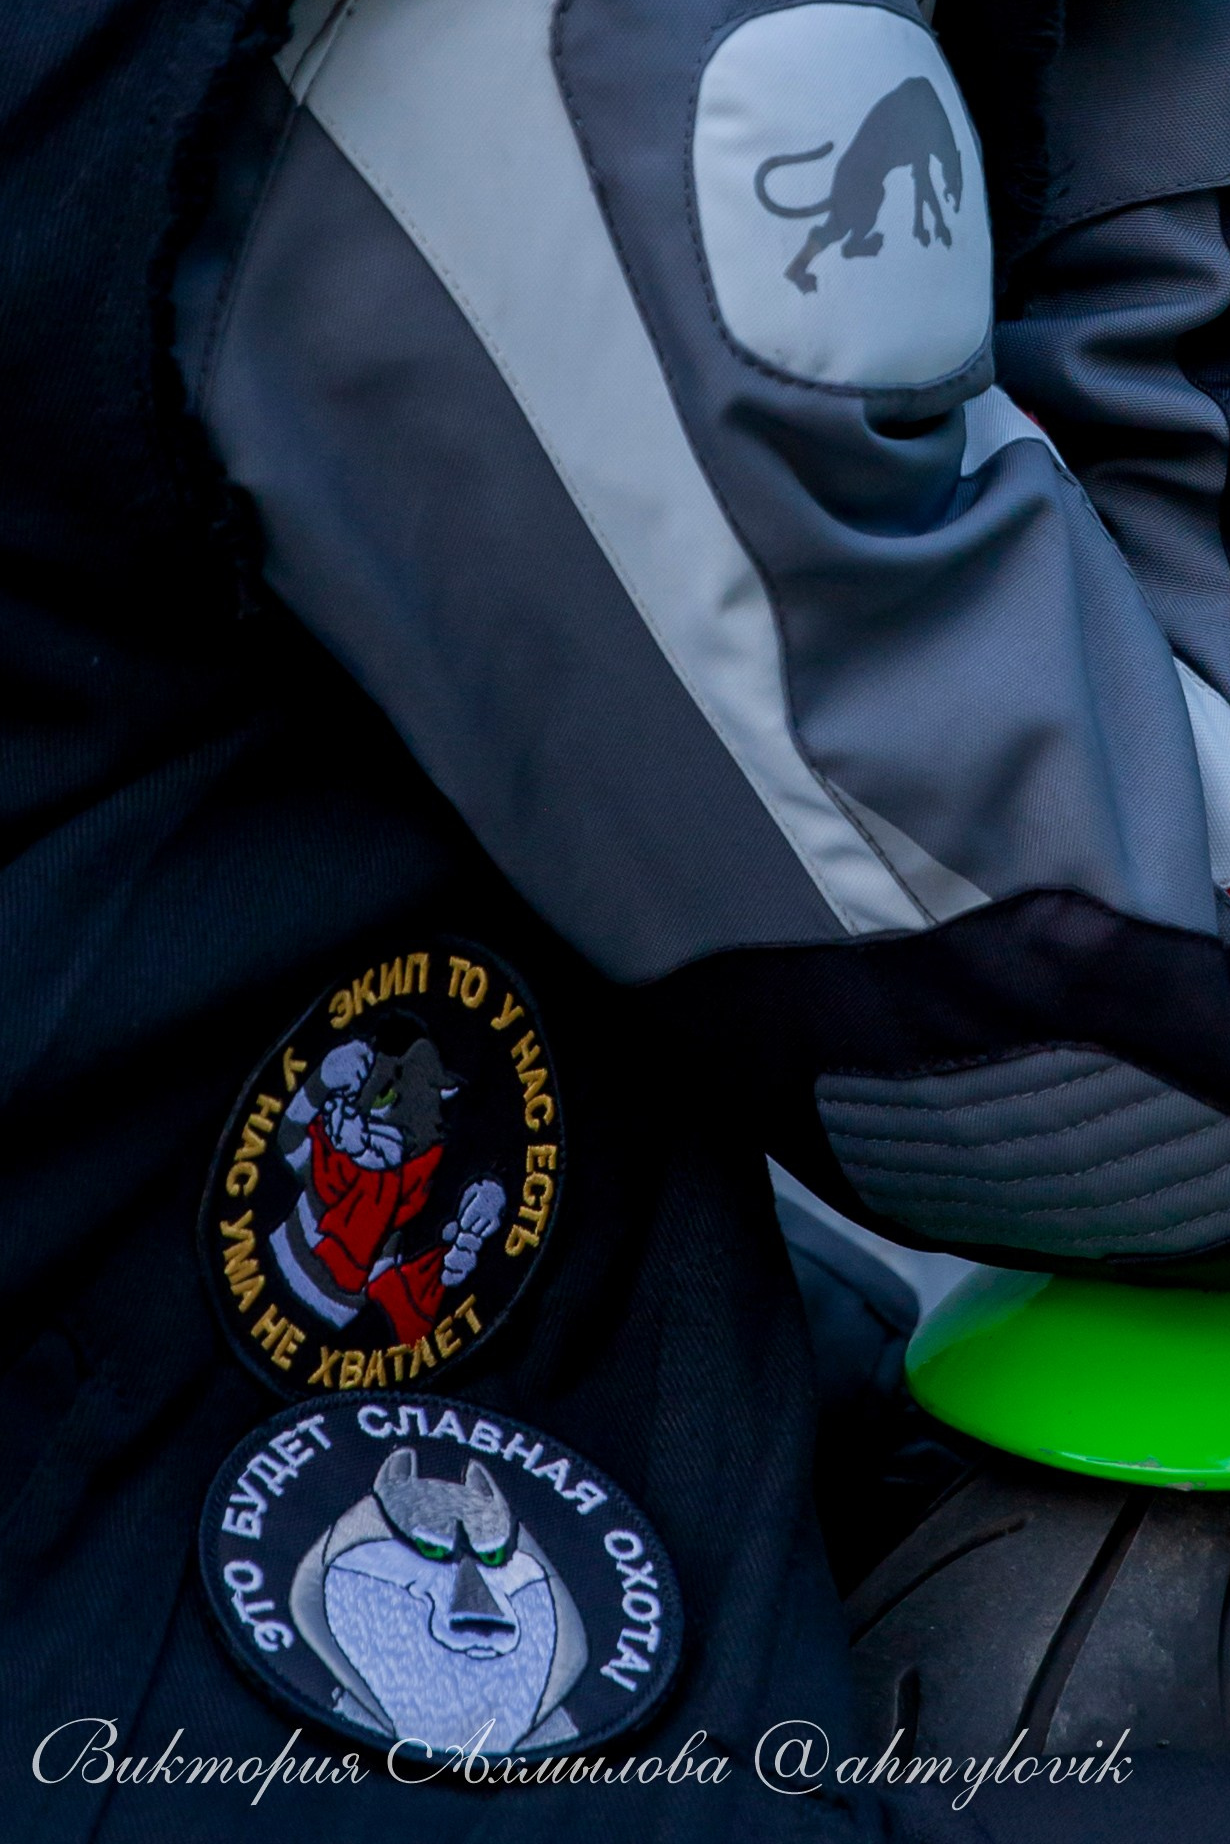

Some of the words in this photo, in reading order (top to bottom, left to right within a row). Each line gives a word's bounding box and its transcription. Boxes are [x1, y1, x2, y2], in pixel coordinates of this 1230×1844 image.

[329, 952, 430, 1030] ЭКИП
[448, 956, 489, 1009] ТО
[491, 994, 525, 1032] У
[283, 1046, 307, 1092] У
[510, 1030, 555, 1132] НАС
[225, 1093, 283, 1198] НАС
[505, 1144, 557, 1257] ЕСТЬ
[220, 1210, 265, 1313] УМА
[251, 1303, 307, 1370] НЕ
[221, 1413, 332, 1540] БУДЕТ
[356, 1404, 609, 1516] СЛАВНАЯ
[223, 1560, 294, 1653] ЭТО
